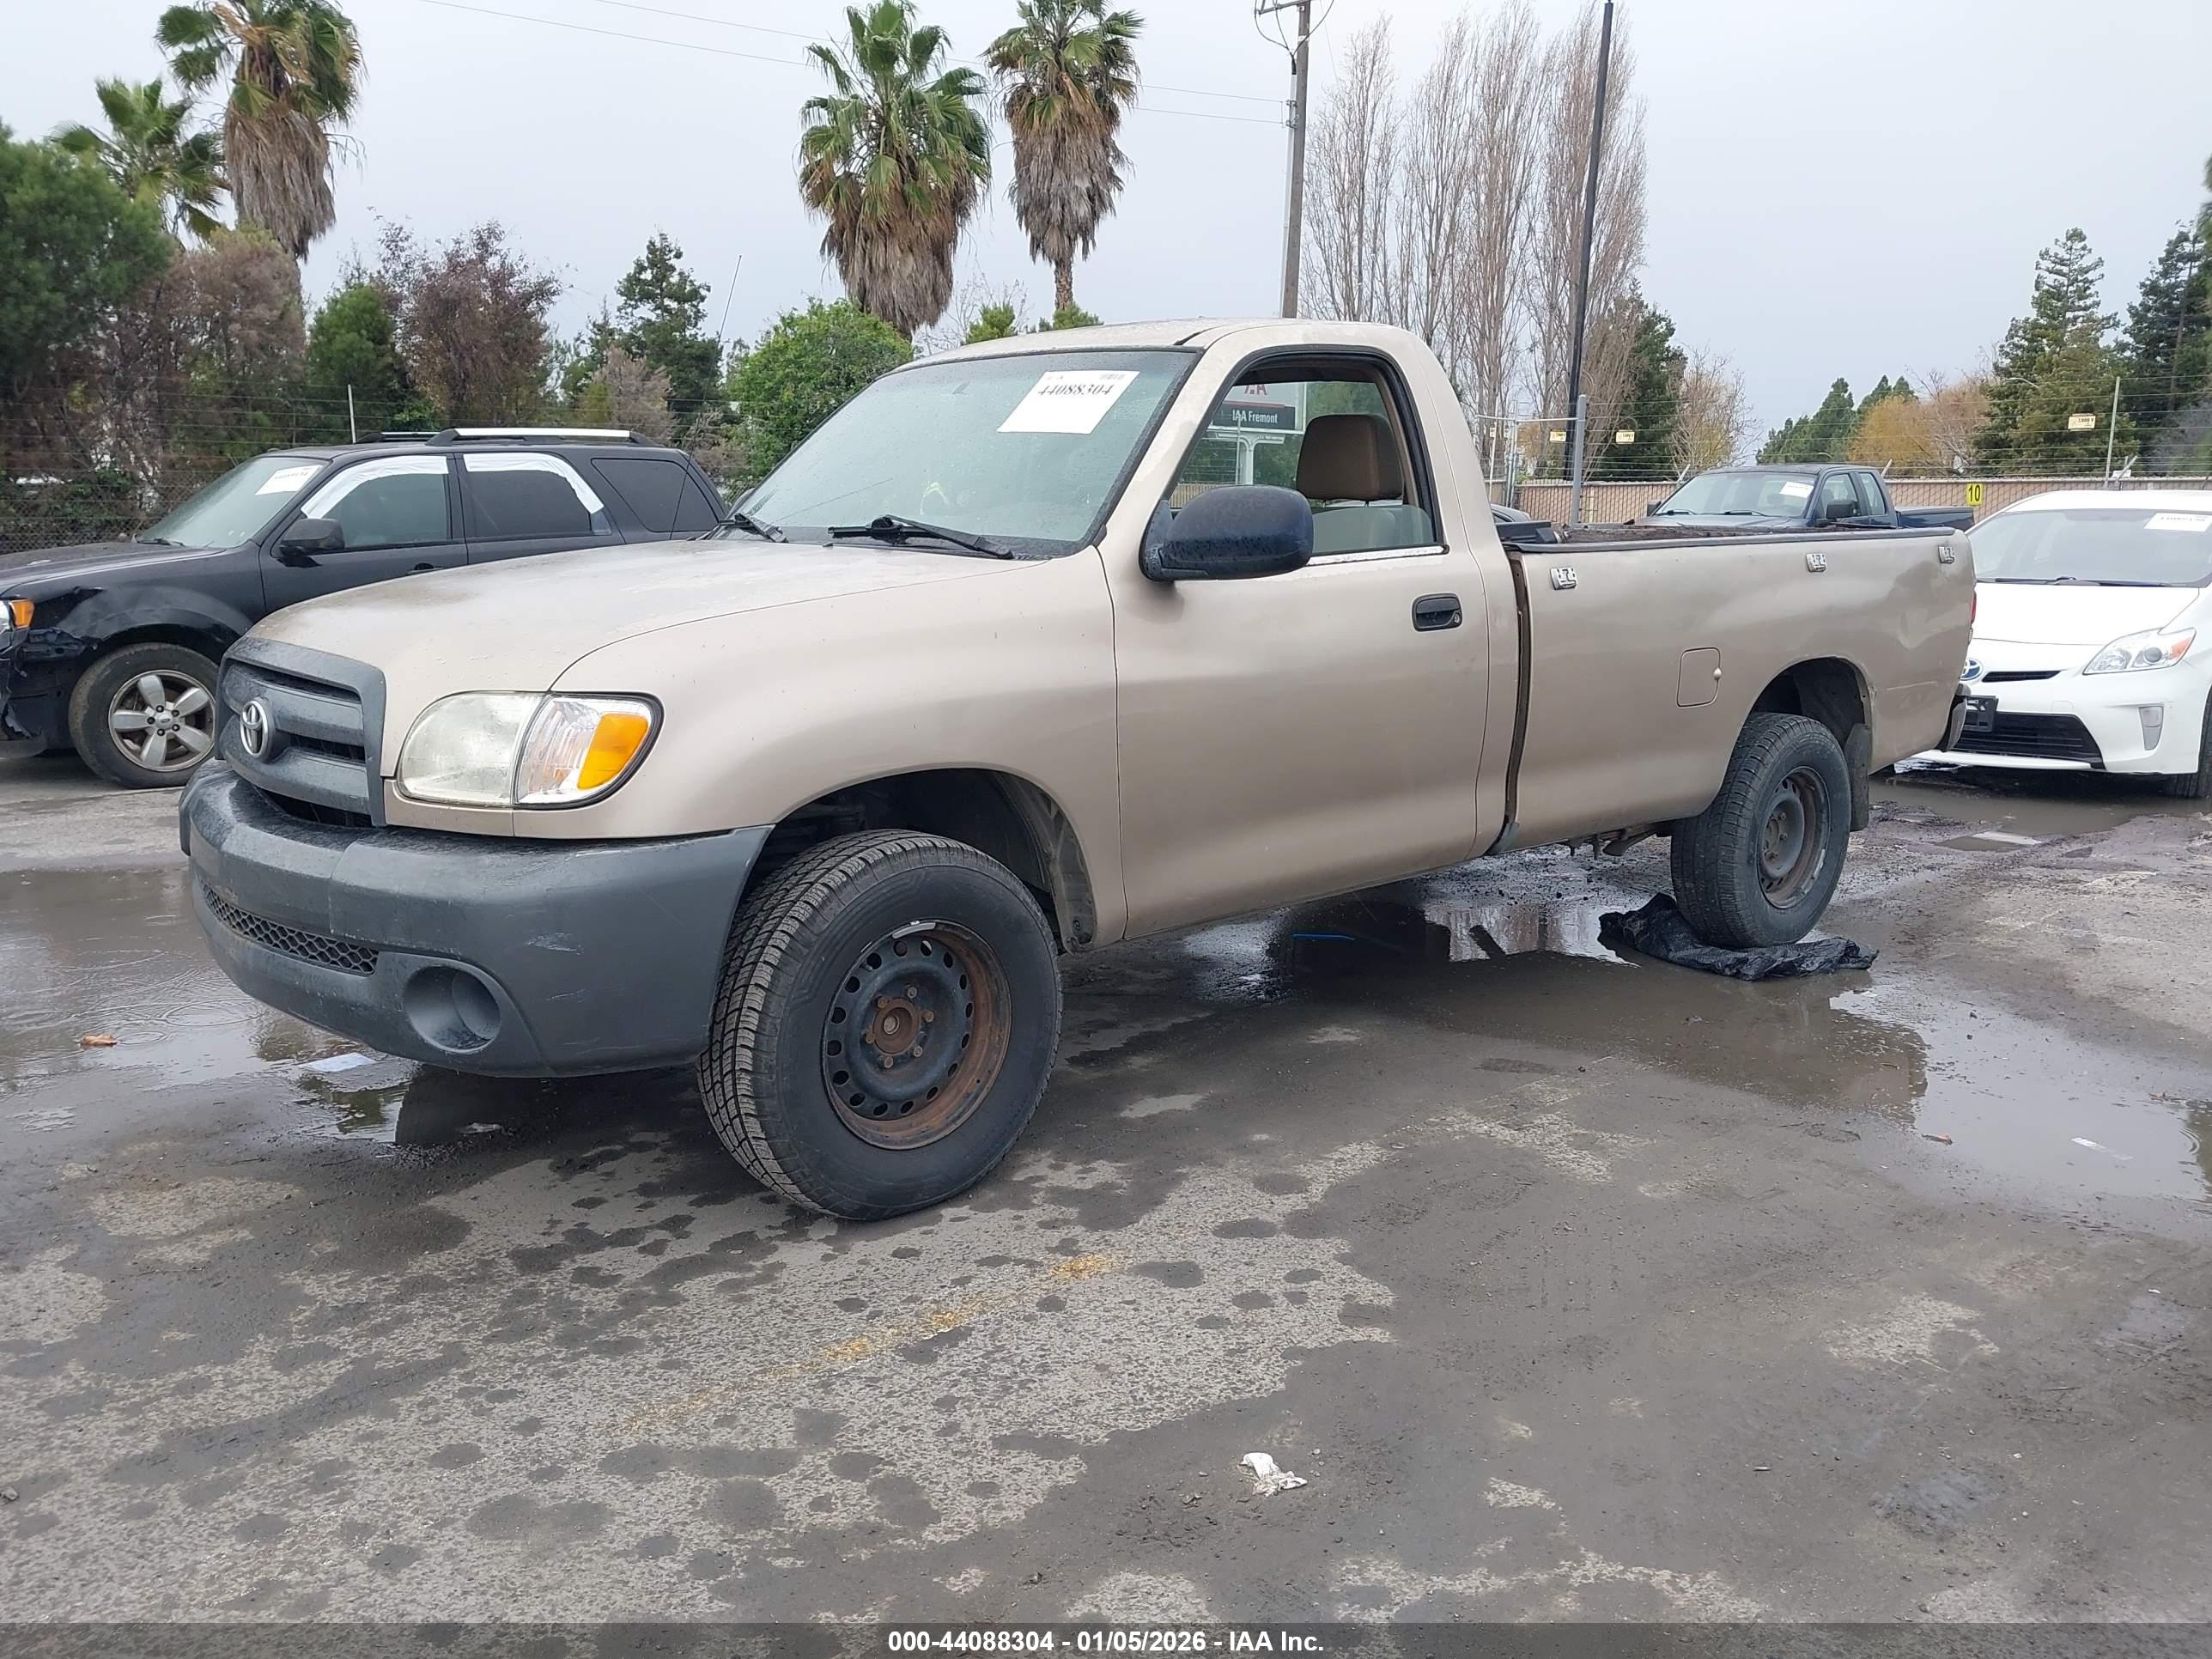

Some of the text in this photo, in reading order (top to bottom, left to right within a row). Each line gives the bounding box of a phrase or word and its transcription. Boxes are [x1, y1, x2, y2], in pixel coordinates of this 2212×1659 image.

[1037, 384, 1115, 396] 44088304
[1232, 409, 1278, 424] IAA Fremont
[1968, 484, 1981, 502] 10
